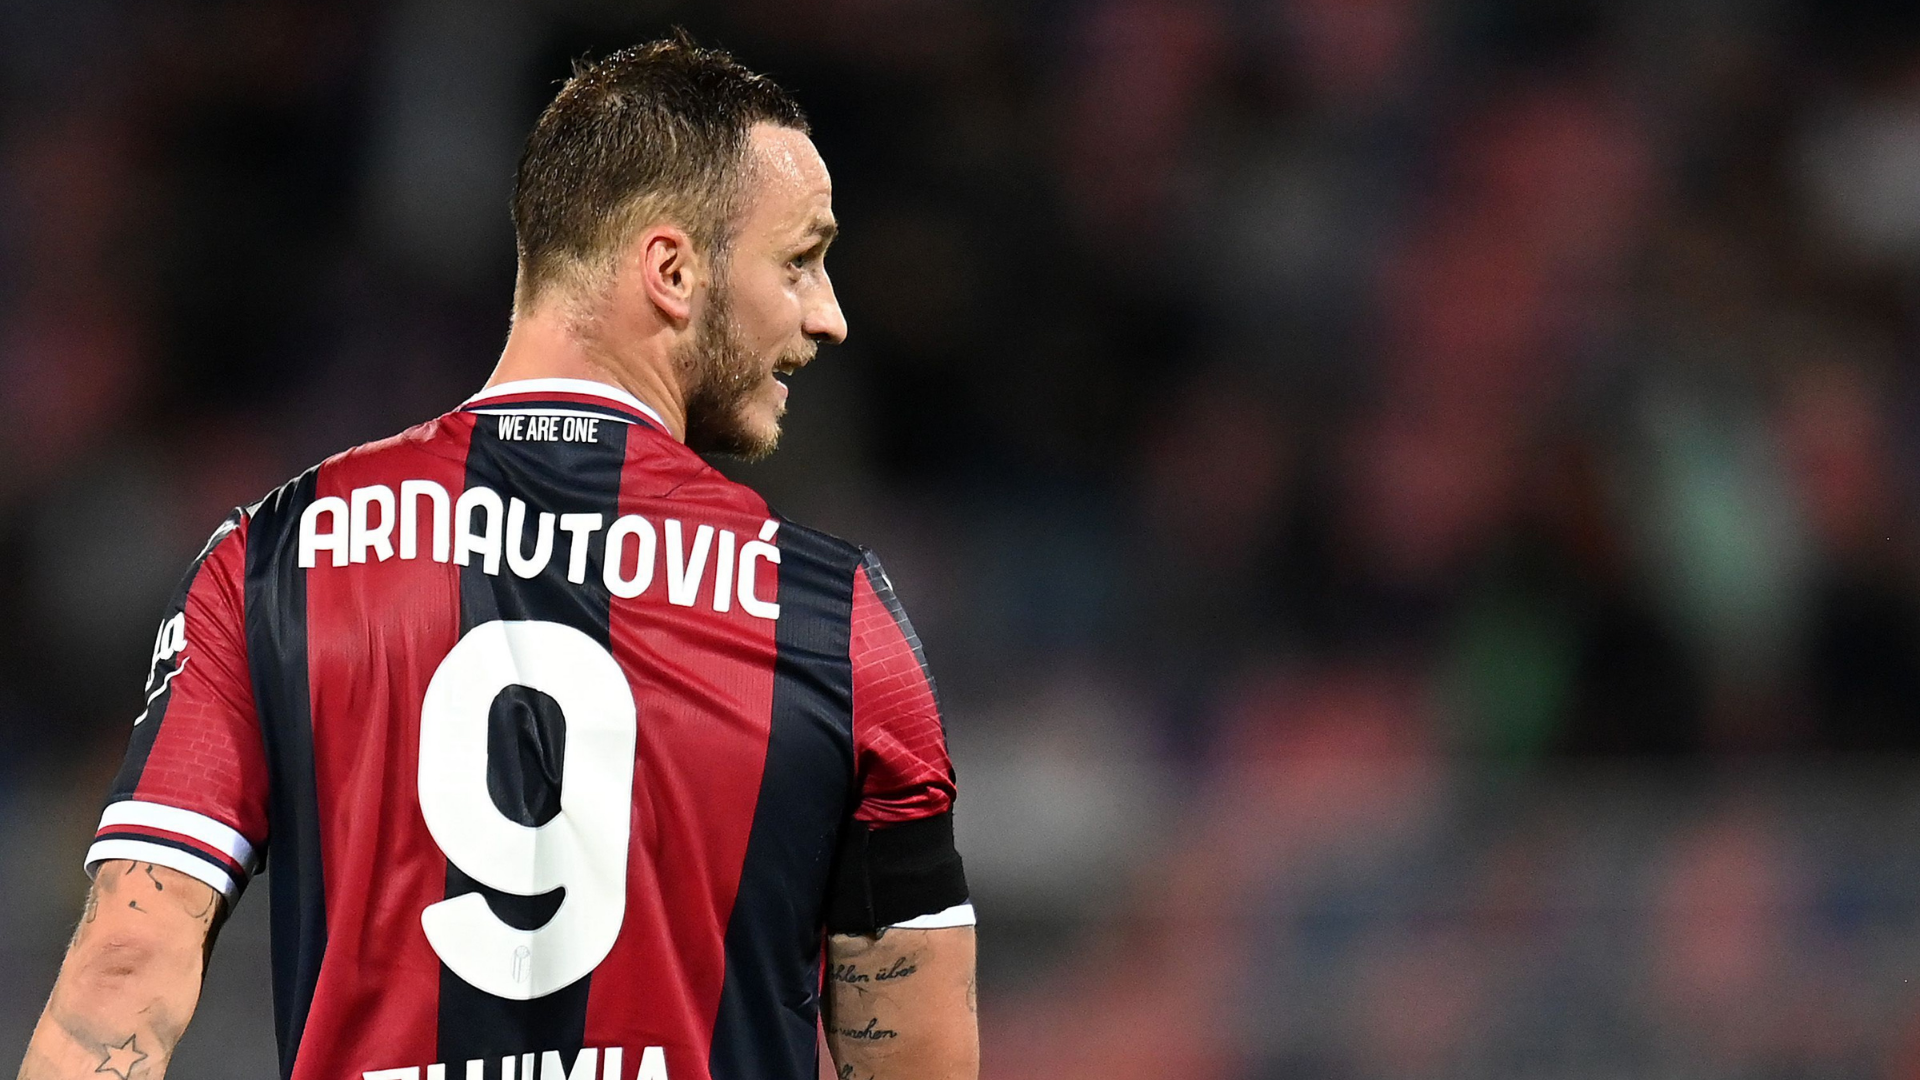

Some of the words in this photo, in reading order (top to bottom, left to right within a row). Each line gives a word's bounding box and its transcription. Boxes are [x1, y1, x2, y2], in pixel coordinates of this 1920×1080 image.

[498, 415, 525, 441] WE
[525, 416, 561, 442] ARE
[562, 417, 599, 443] ONE
[298, 479, 782, 620] ARNAUTOVIĆ
[417, 619, 637, 1001] 9
